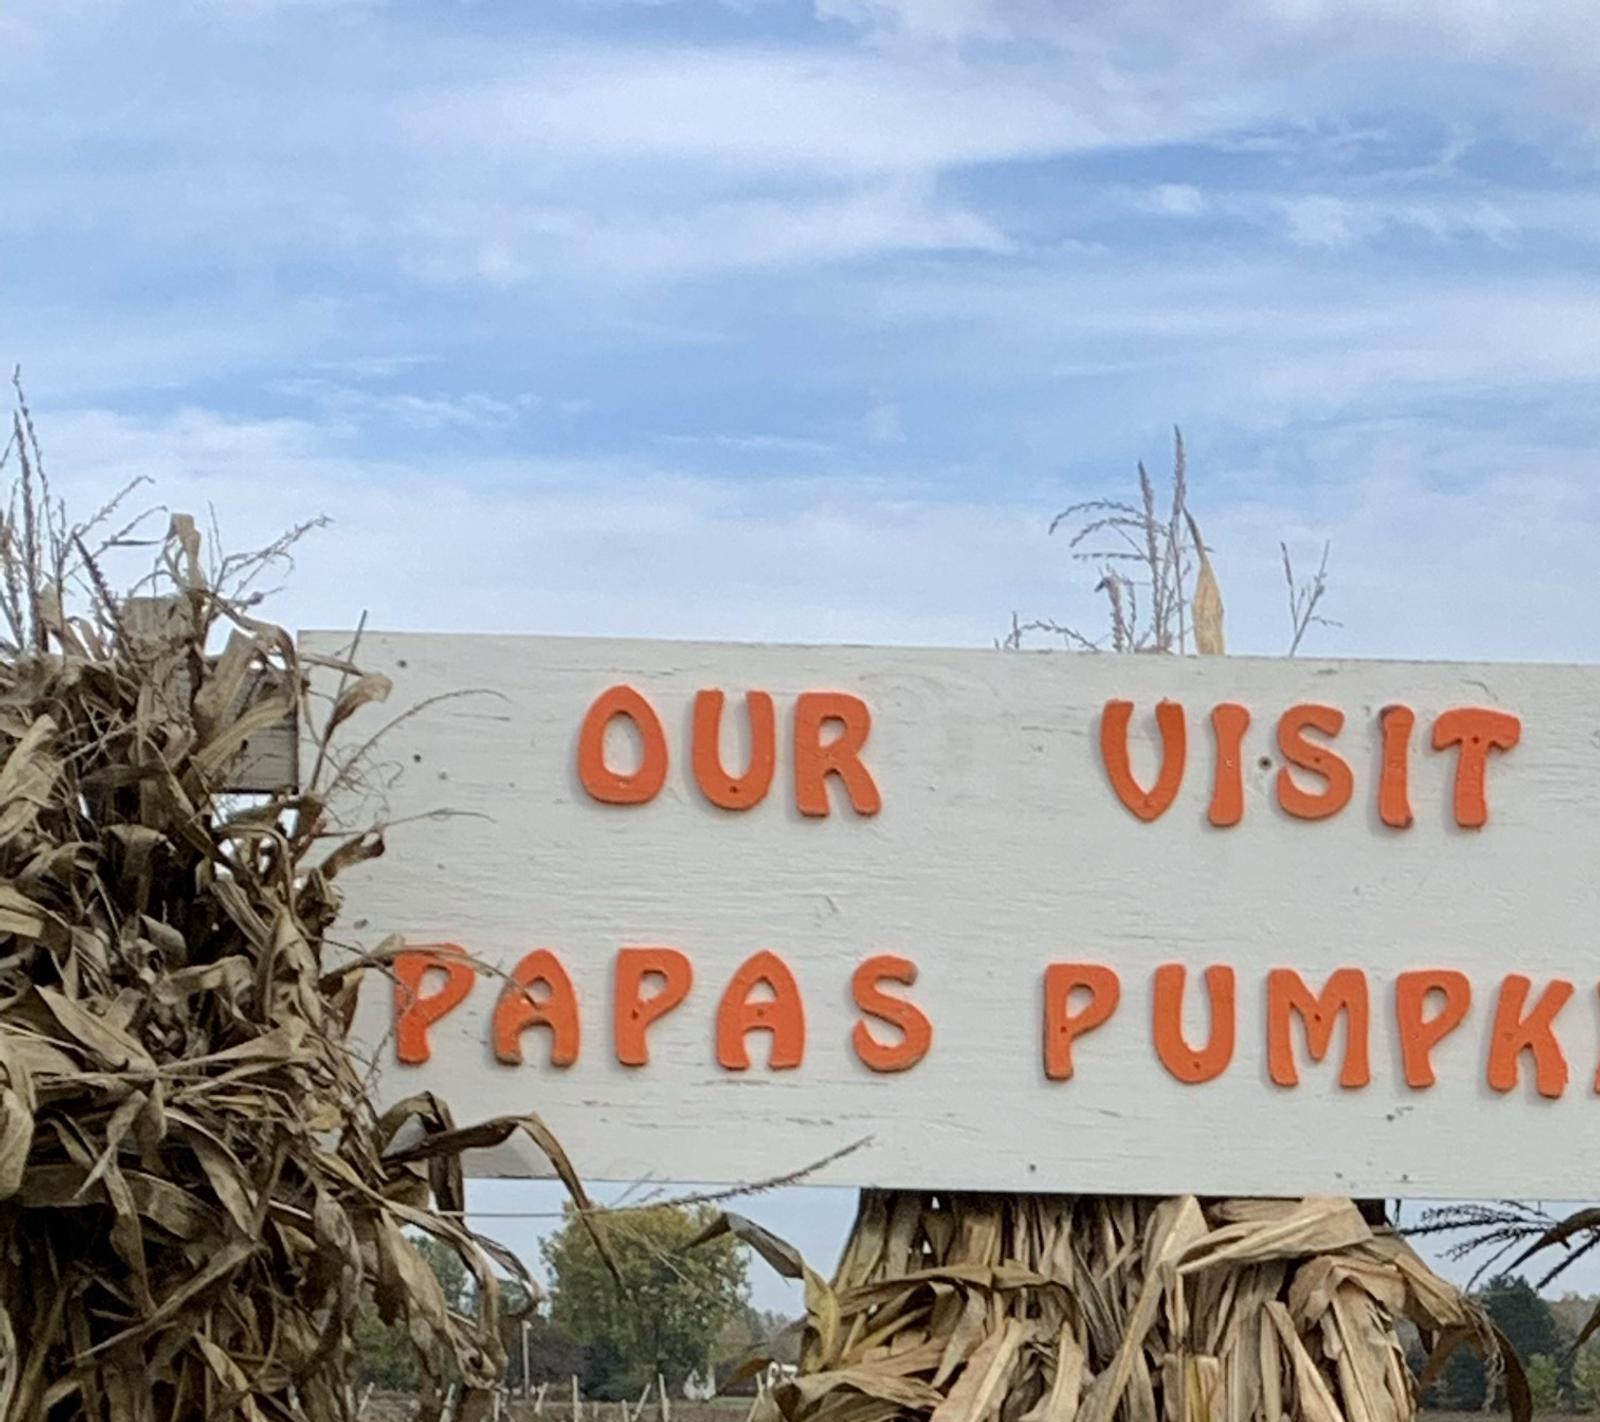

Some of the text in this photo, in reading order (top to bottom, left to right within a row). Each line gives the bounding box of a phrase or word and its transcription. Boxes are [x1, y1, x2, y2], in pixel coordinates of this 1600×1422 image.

[577, 685, 882, 818] OUR
[1100, 699, 1522, 830] VISIT
[393, 943, 933, 1073] PAPAS
